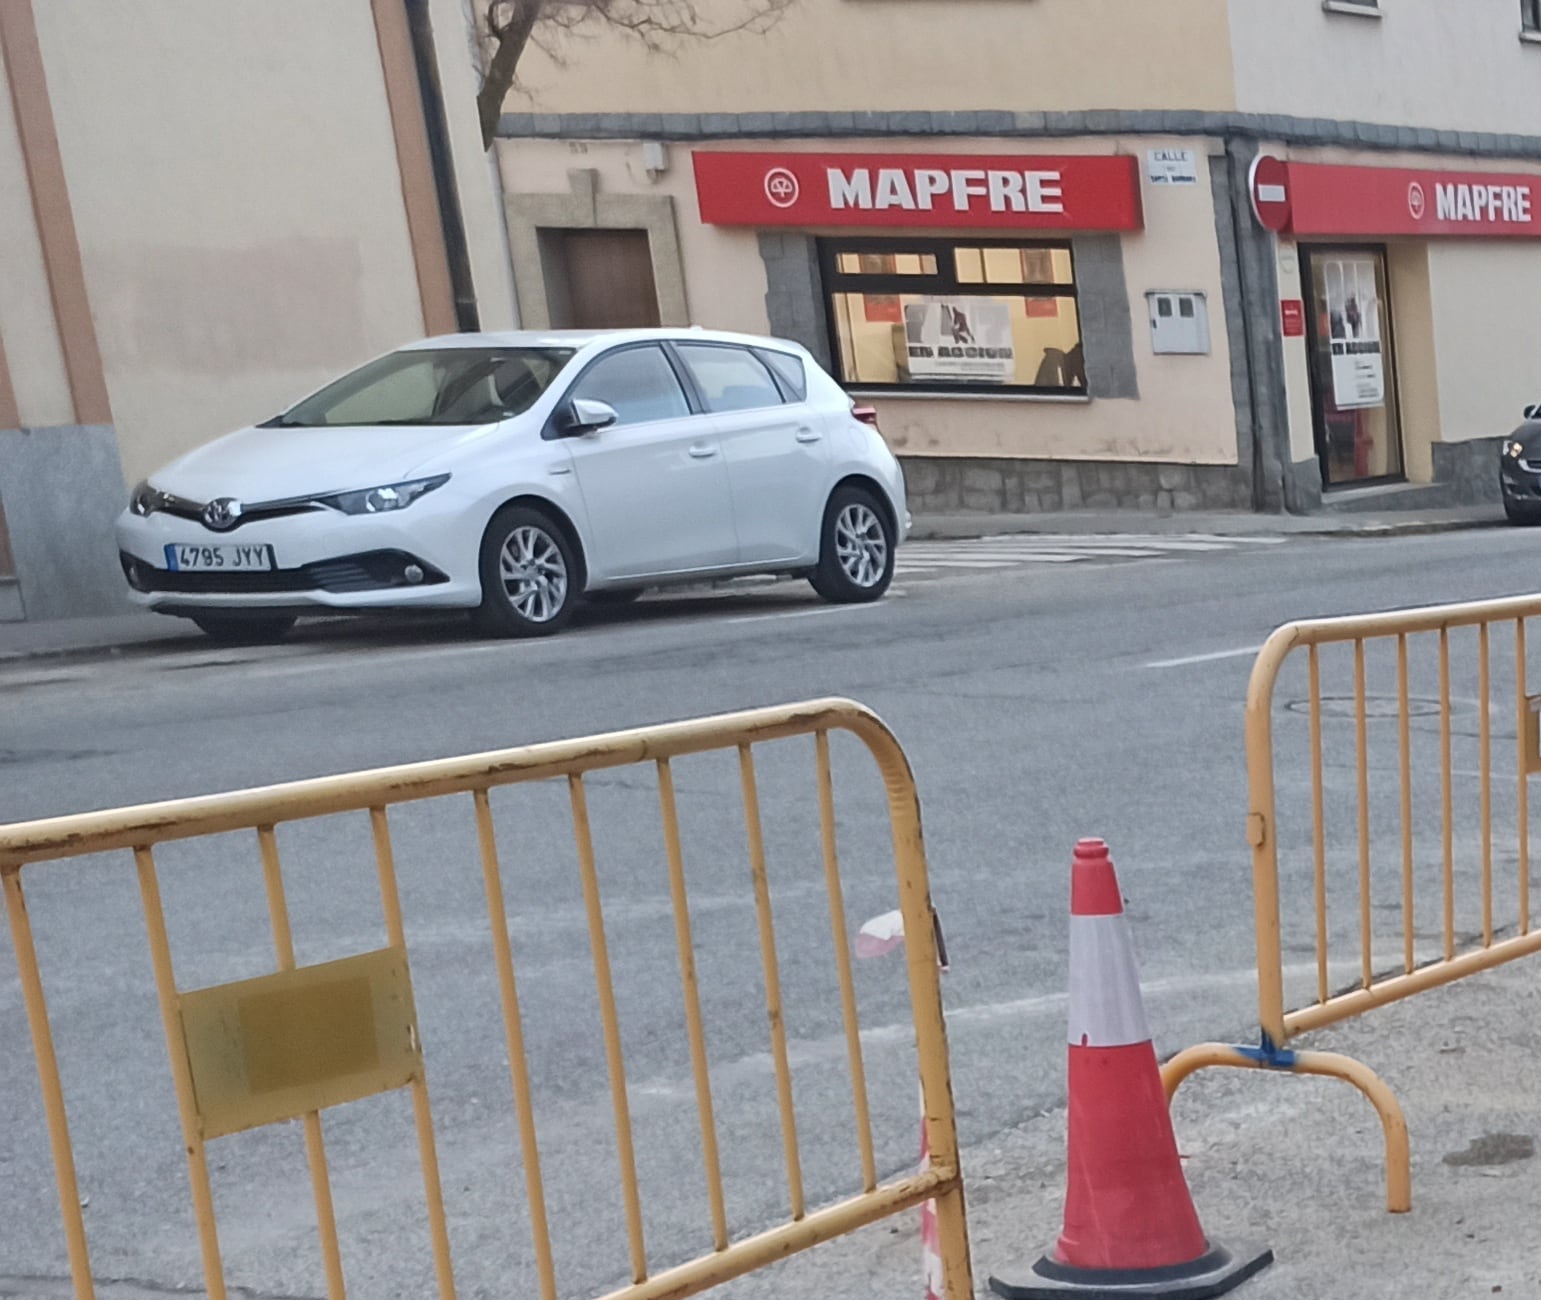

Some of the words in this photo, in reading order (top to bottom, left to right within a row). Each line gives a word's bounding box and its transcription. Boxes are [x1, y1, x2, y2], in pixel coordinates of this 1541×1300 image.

[1153, 151, 1188, 162] CALLE
[826, 167, 1064, 213] MAPFRE
[1435, 182, 1532, 222] MAPFRE
[232, 547, 263, 567] JYY
